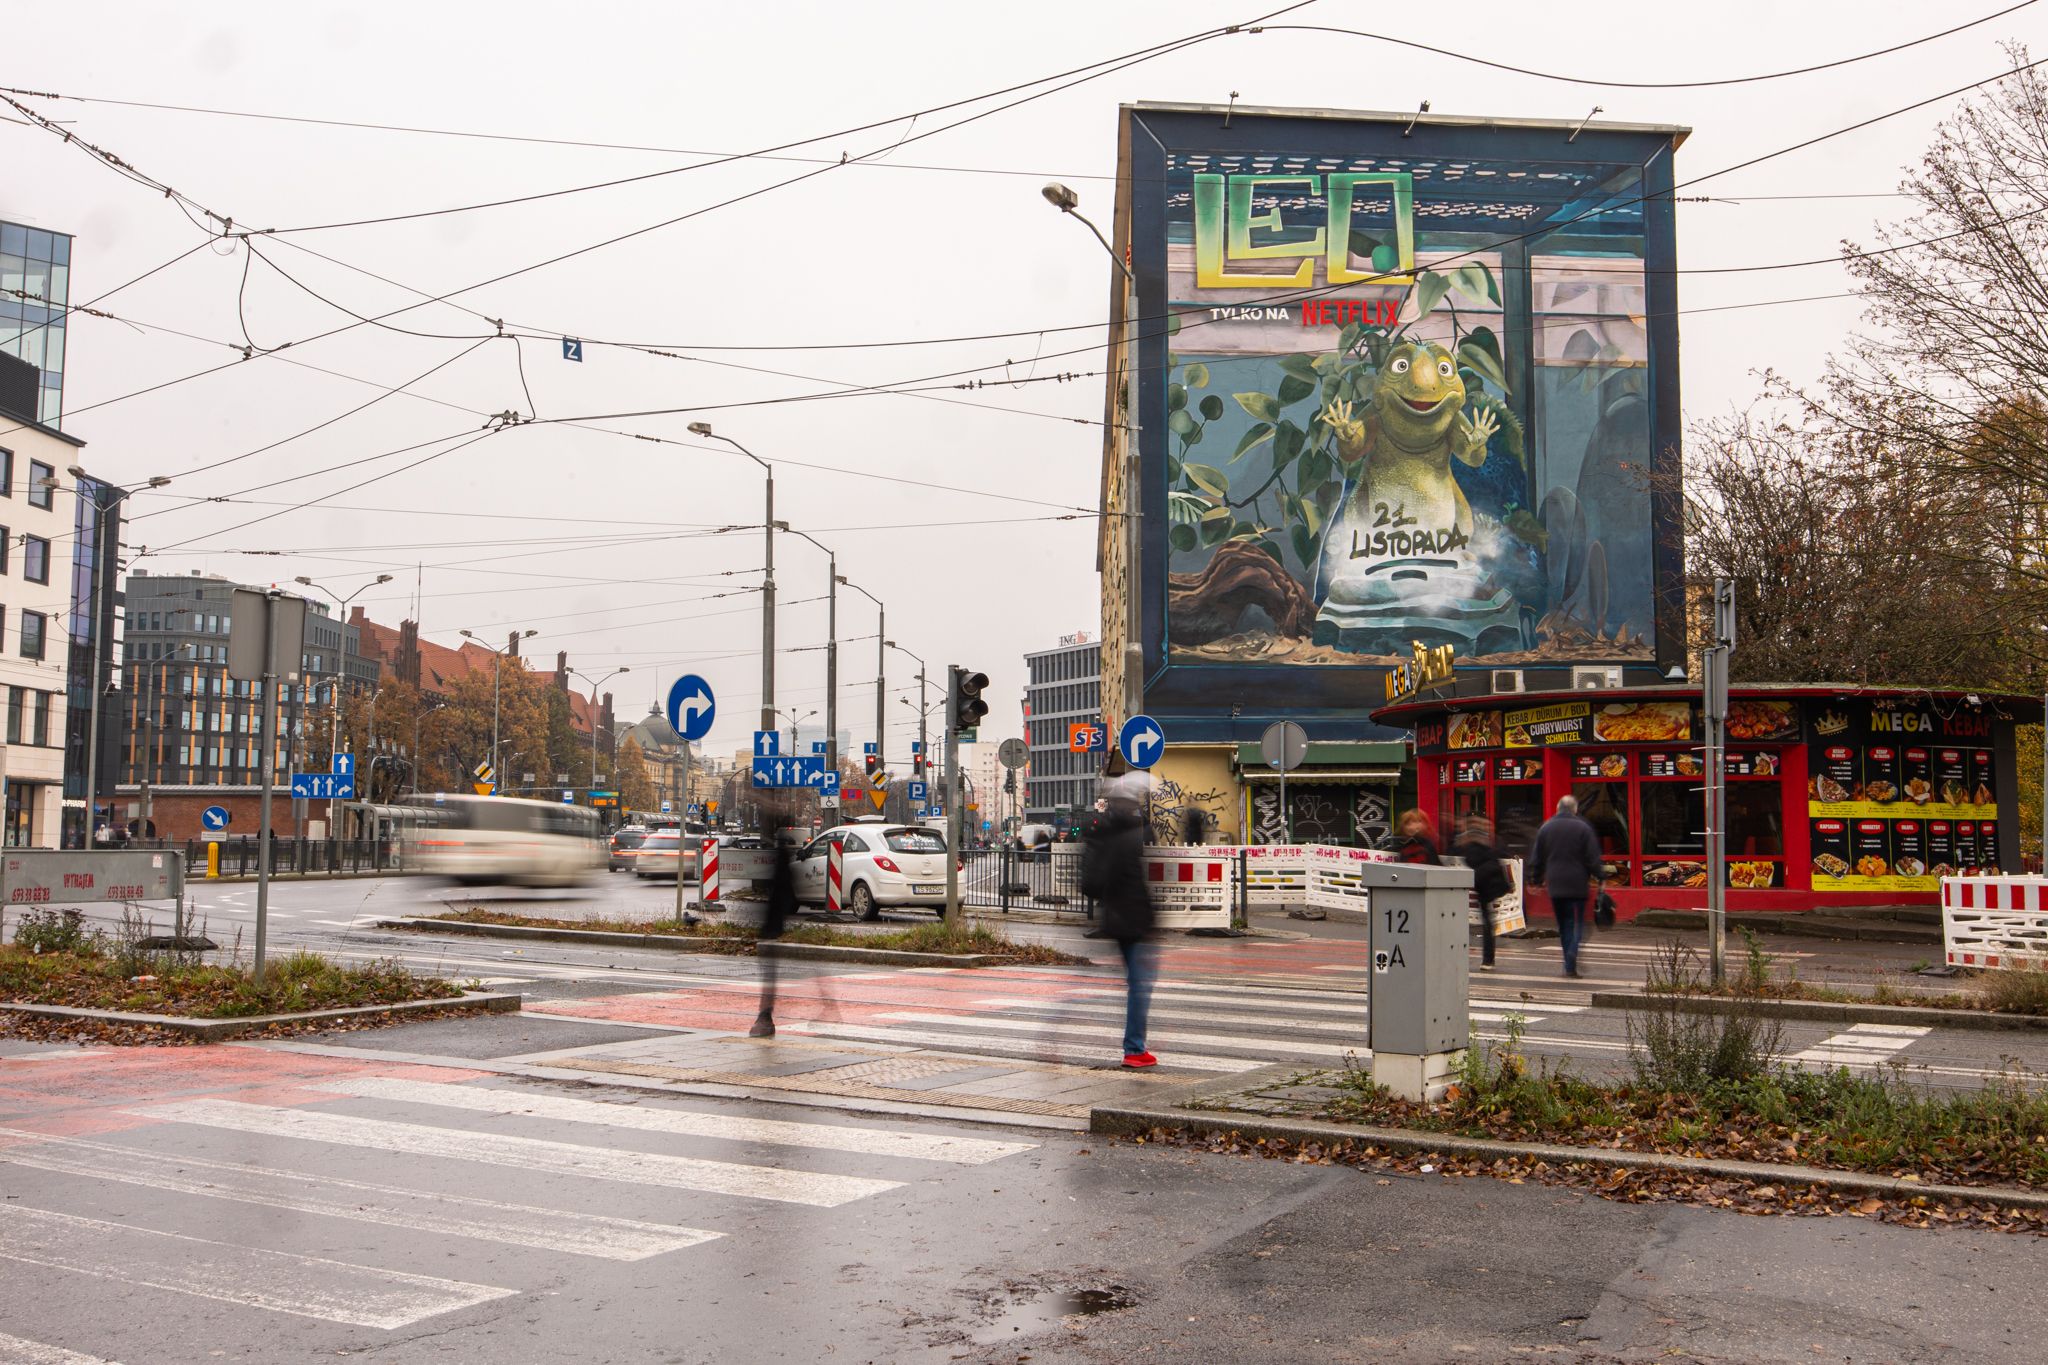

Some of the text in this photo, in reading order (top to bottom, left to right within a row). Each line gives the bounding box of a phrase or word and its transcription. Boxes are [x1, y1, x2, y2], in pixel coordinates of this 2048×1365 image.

[1194, 173, 1414, 289] LEO
[1210, 300, 1399, 327] TYLKO NA NETFLIX
[567, 341, 579, 360] Z
[1349, 523, 1469, 560] LISTOPADA
[1385, 663, 1412, 701] MEGA
[1506, 712, 1529, 726] KEBAB
[1570, 703, 1587, 716] BOX
[1871, 712, 1933, 732] MEGA
[1943, 715, 1990, 737] KEBAP
[1074, 727, 1104, 749] STS
[1530, 718, 1584, 736] CURRYWURST
[1545, 731, 1581, 745] SCHNITZEL
[1384, 909, 1410, 934] 12
[1389, 943, 1406, 968] A
